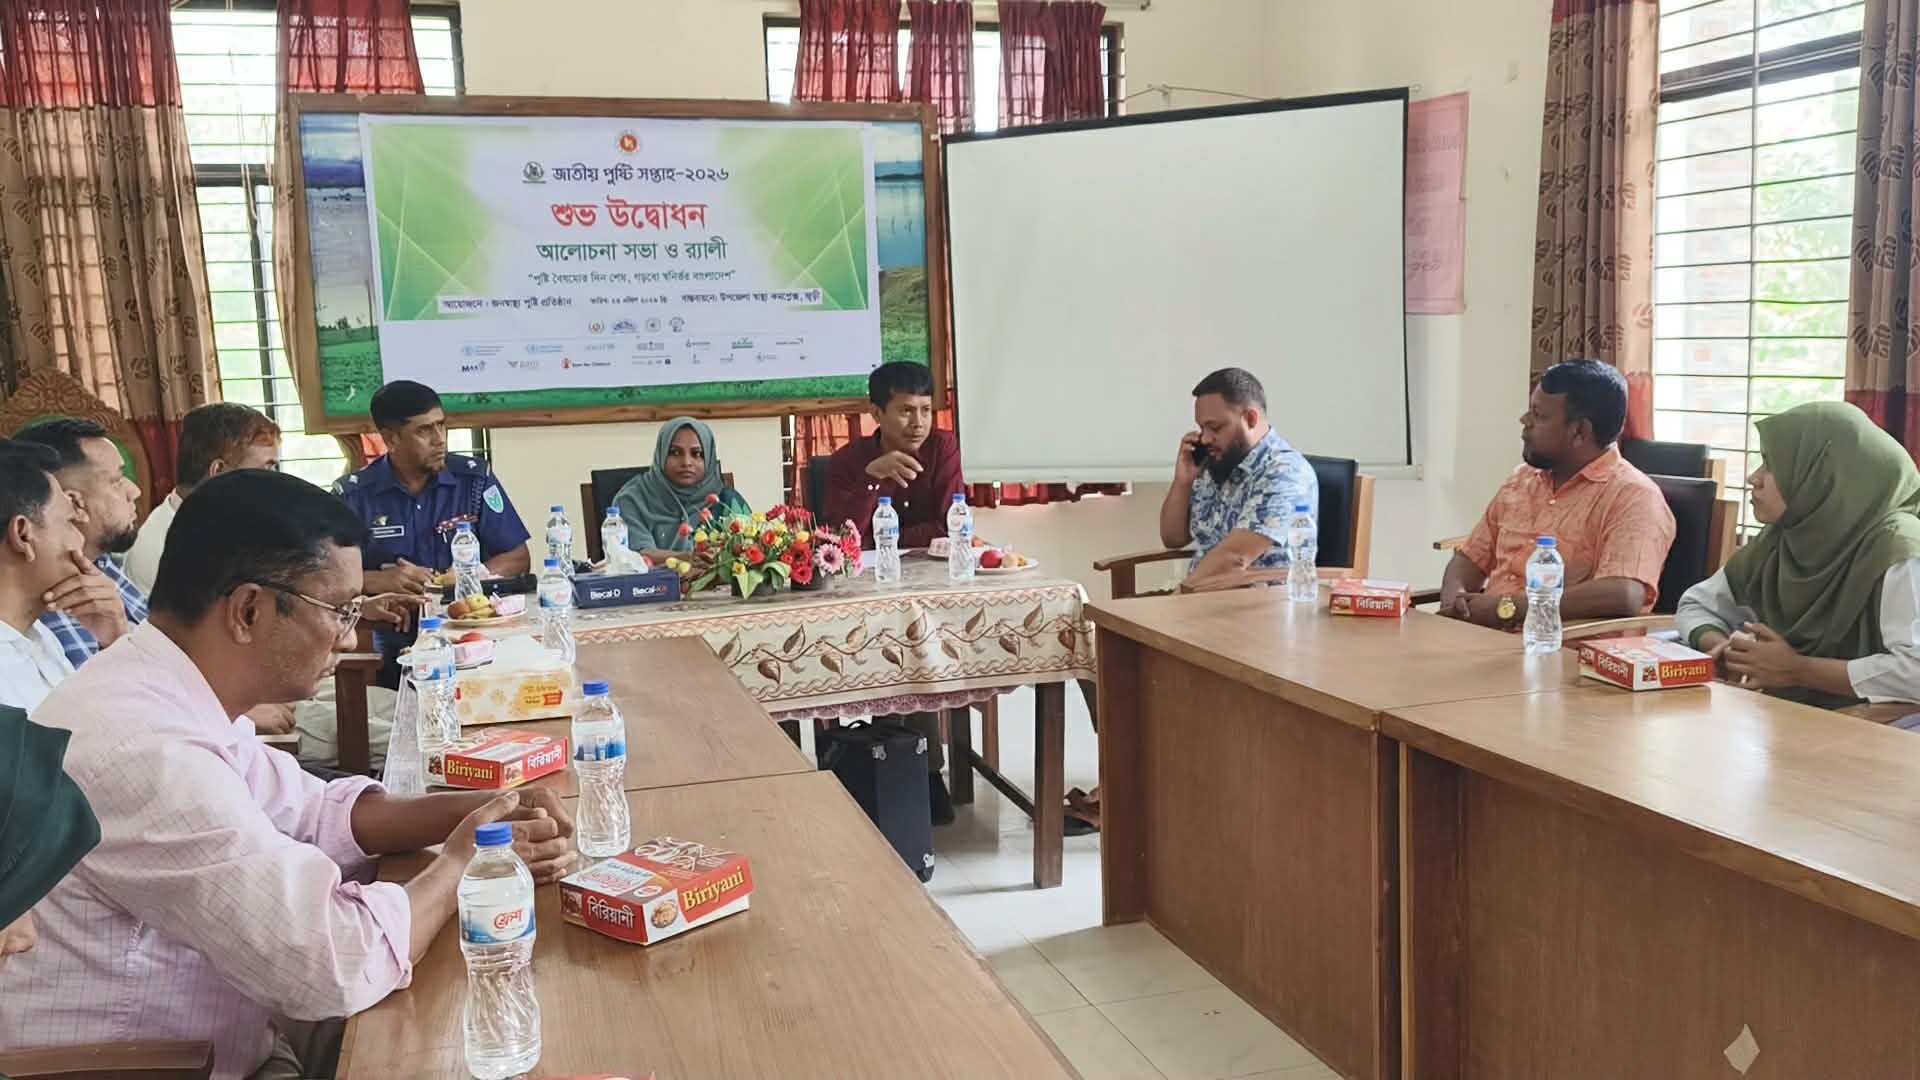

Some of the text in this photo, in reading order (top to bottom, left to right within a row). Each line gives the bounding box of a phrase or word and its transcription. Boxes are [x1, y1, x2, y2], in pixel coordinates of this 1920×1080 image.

[552, 163, 730, 186] জাতীয় পুষ্টি সপ্তাহ-২০২৬
[551, 195, 708, 230] শুভ উদ্বোধন
[536, 236, 729, 262] আলোচনা সভা ও র‍্যালী
[1661, 663, 1707, 681] Biriyani
[446, 759, 494, 782] Biriyani
[682, 865, 745, 911] Biriyani
